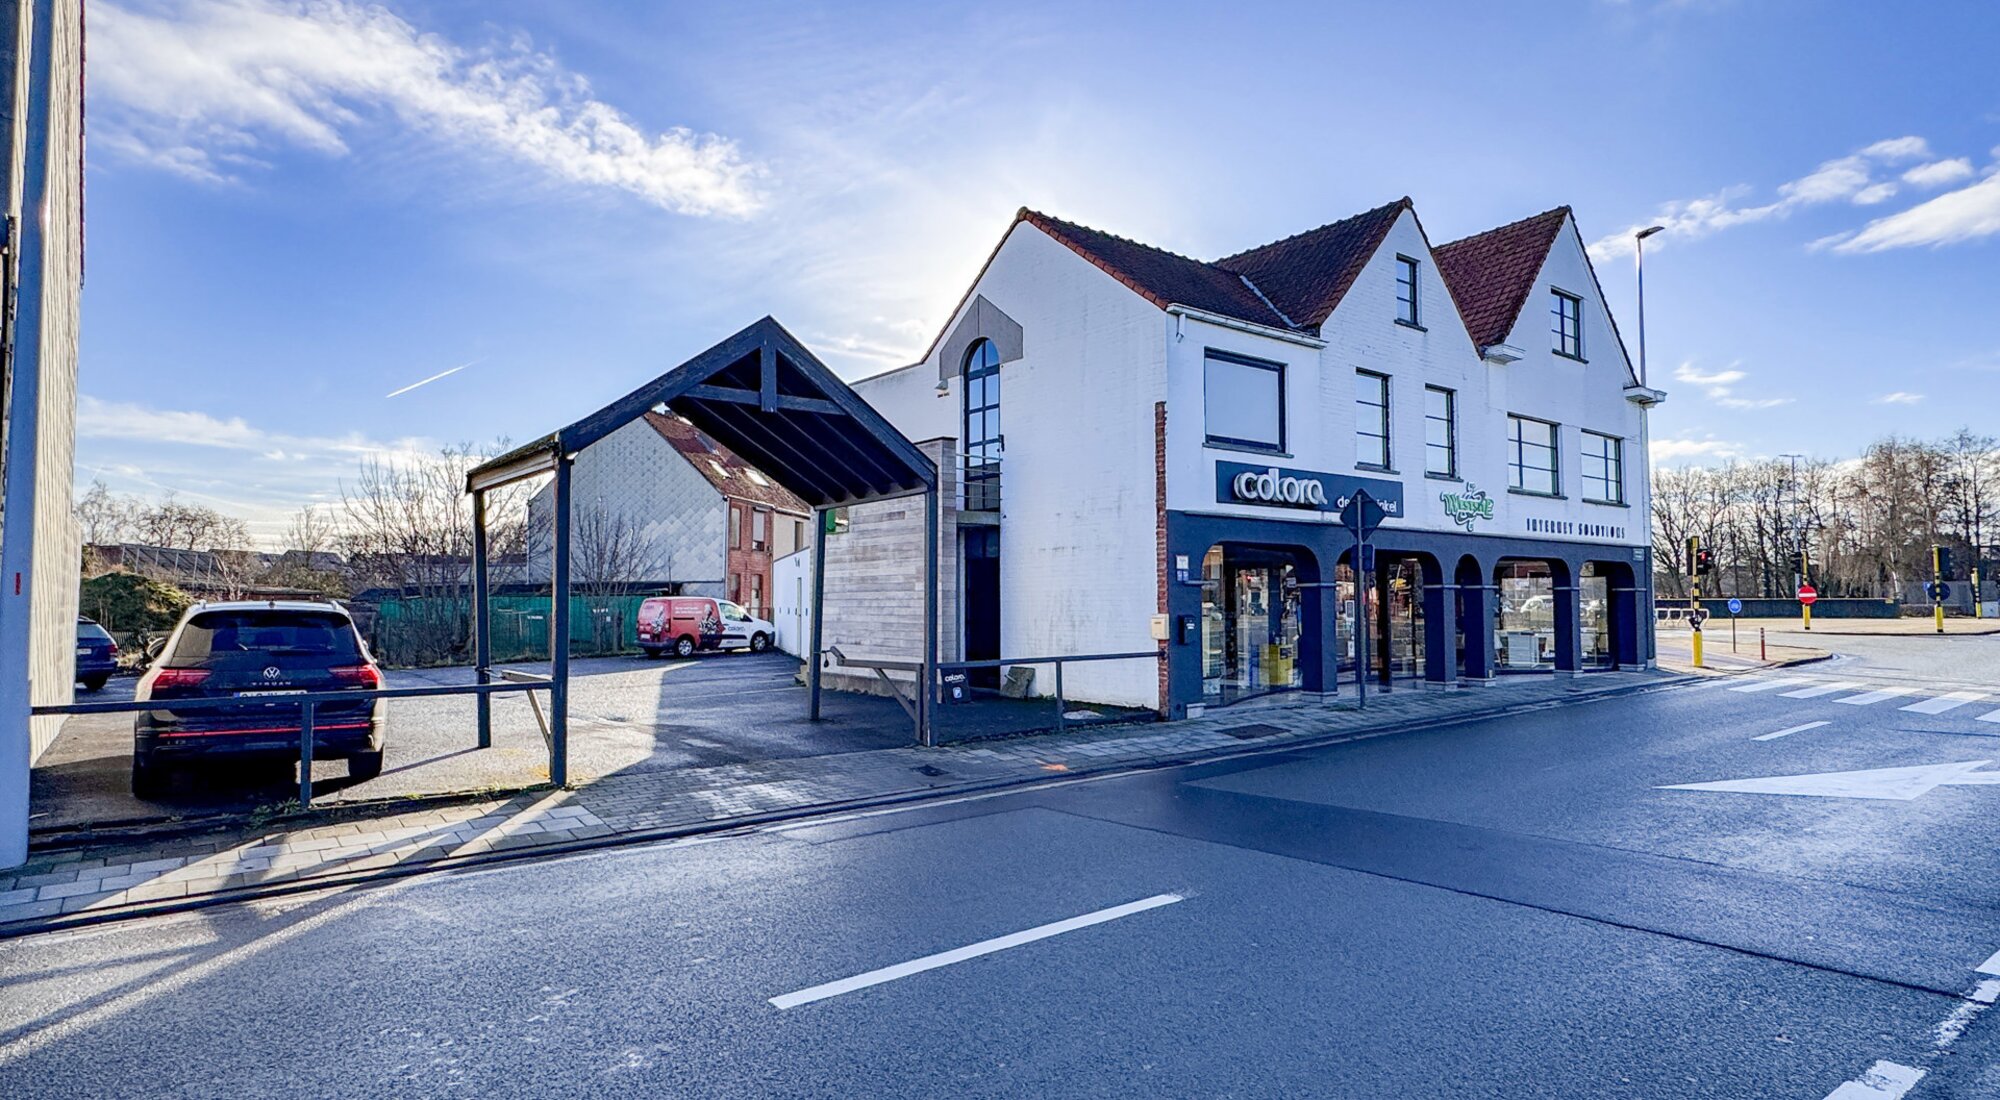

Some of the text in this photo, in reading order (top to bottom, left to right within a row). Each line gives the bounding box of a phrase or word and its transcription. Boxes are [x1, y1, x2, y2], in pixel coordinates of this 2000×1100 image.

[1234, 468, 1328, 505] colora
[1526, 518, 1625, 539] INTERNET SOLUTIONS
[944, 673, 966, 682] colora
